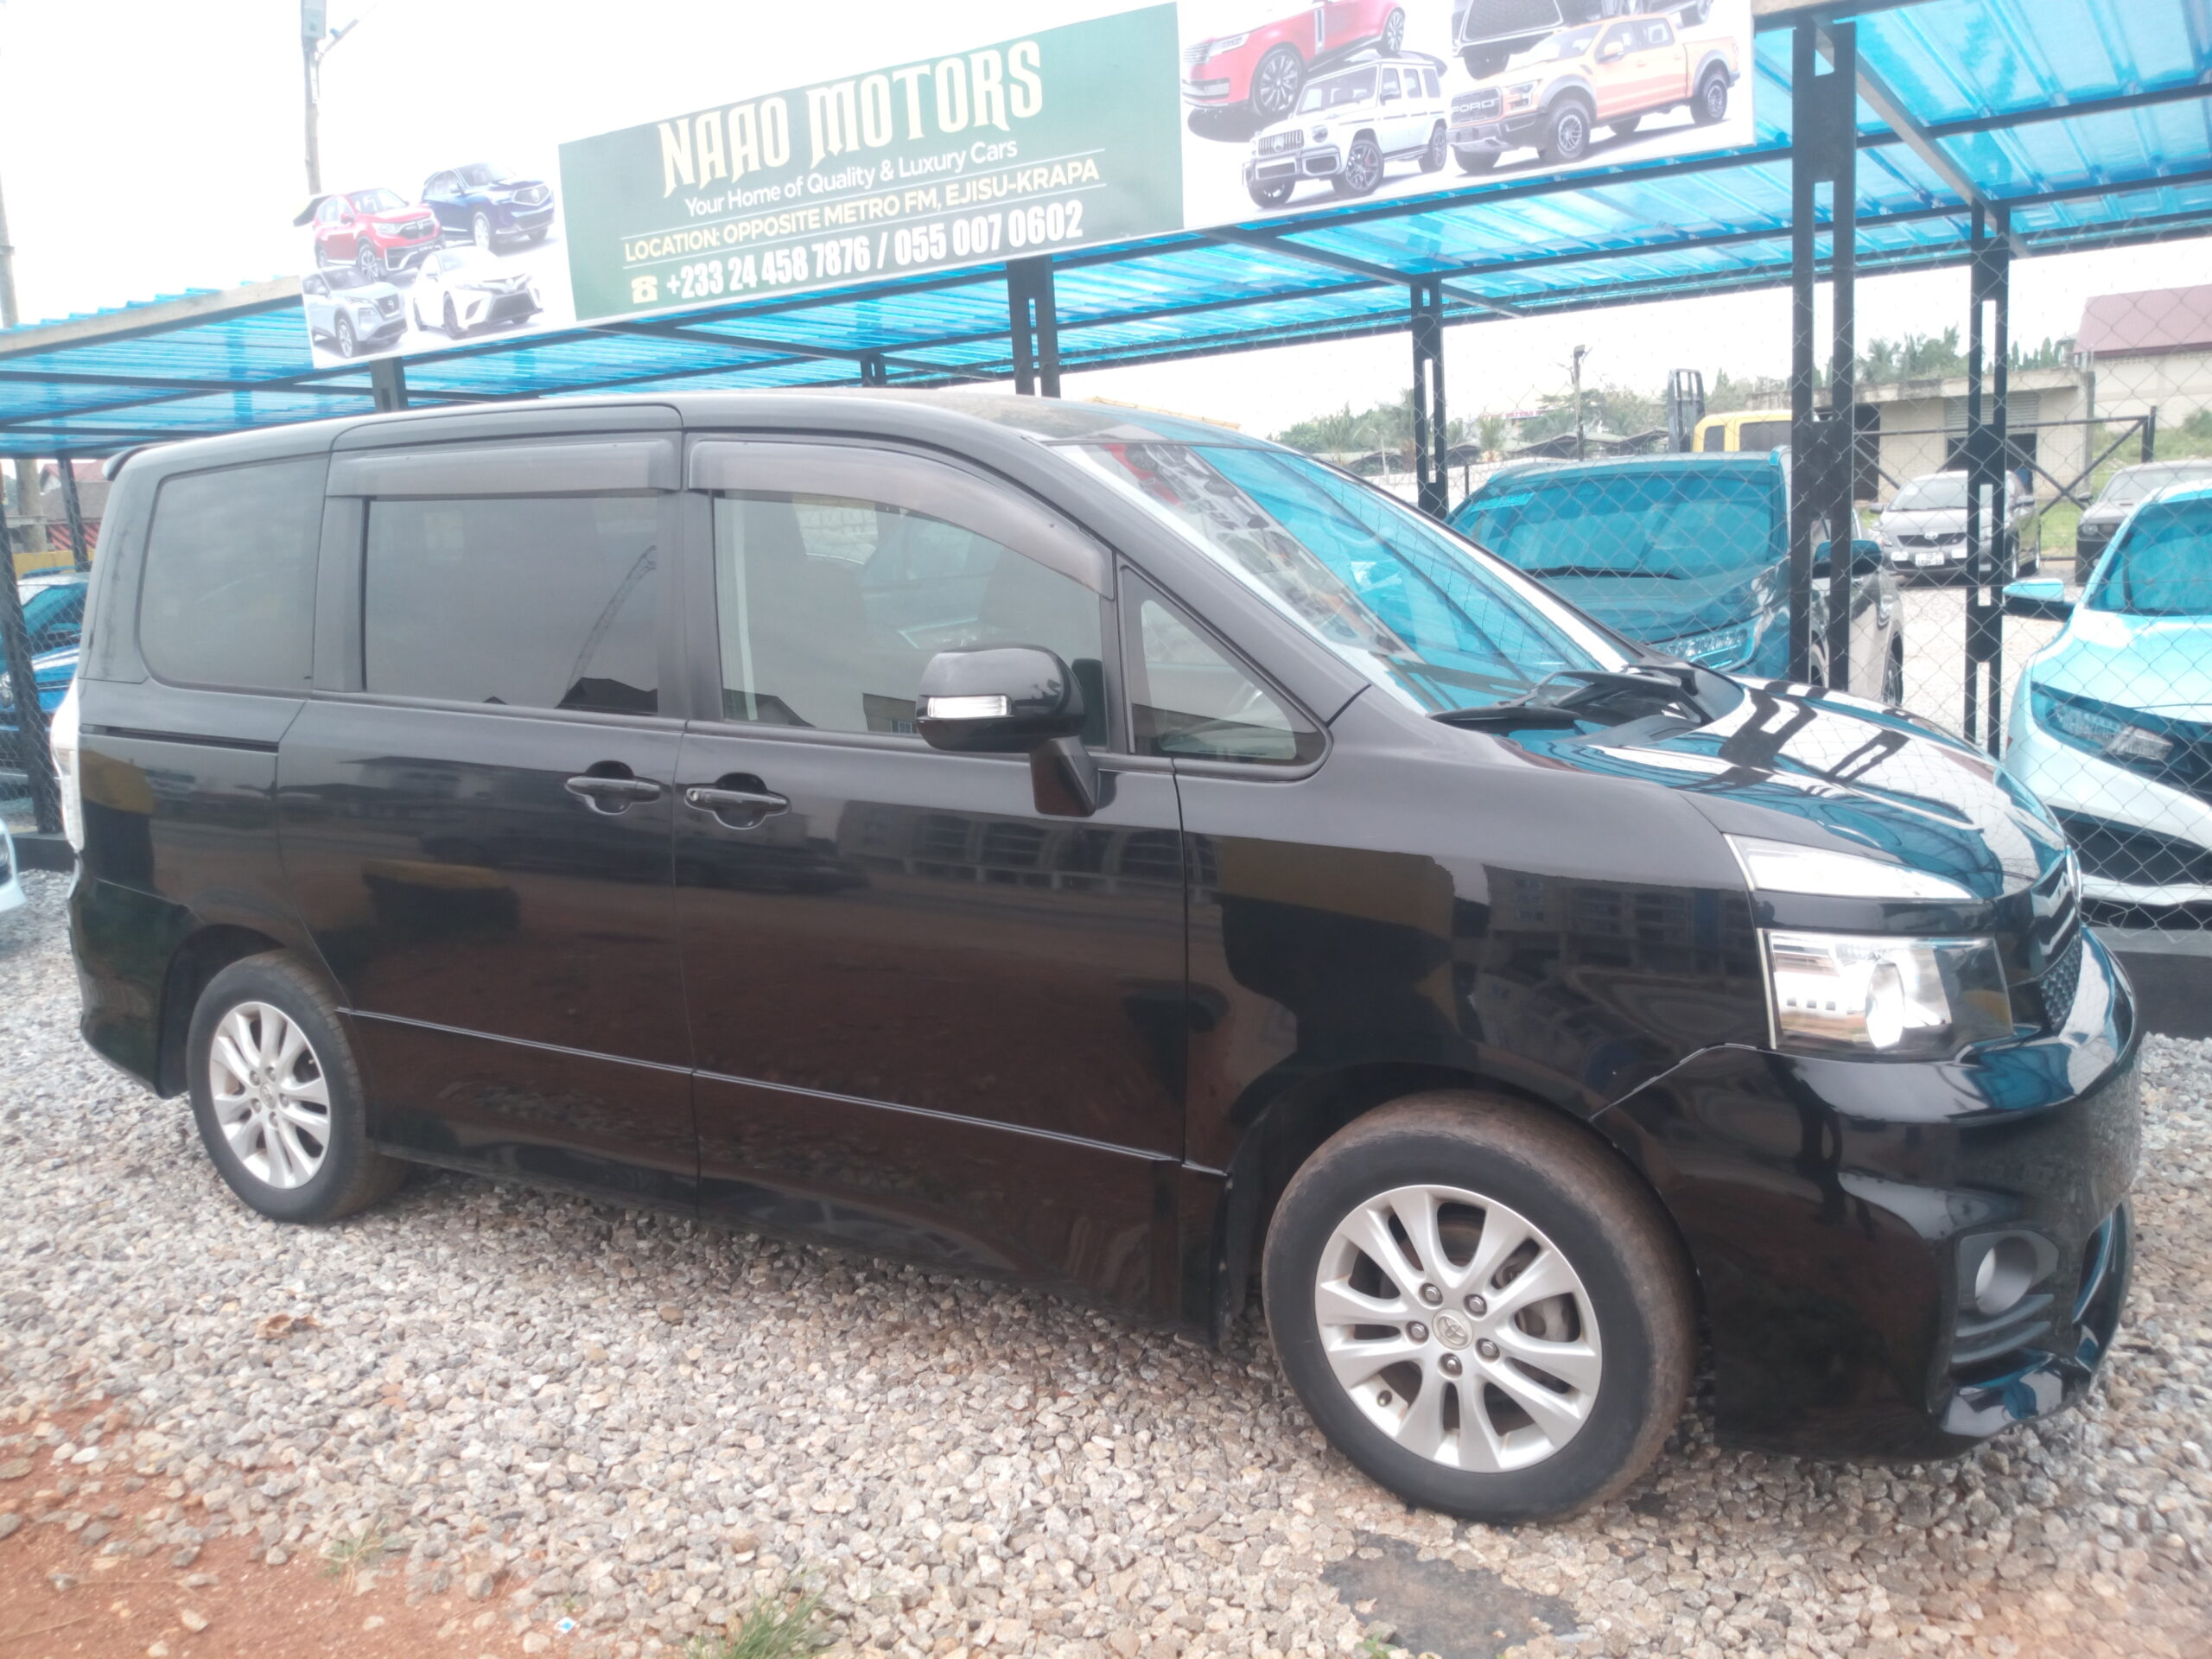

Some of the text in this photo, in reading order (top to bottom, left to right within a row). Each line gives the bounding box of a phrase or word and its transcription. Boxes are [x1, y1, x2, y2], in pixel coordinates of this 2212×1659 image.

[658, 41, 1043, 199] NAAO MOTORS
[624, 158, 1100, 262] LOCATION: OPPOSITE METRO FM, EJISU-KRAPA
[685, 140, 1019, 218] Your Home of Quality & Luxury Cars
[666, 200, 1083, 299] +233 24 458 7876 / 055 007 0602
